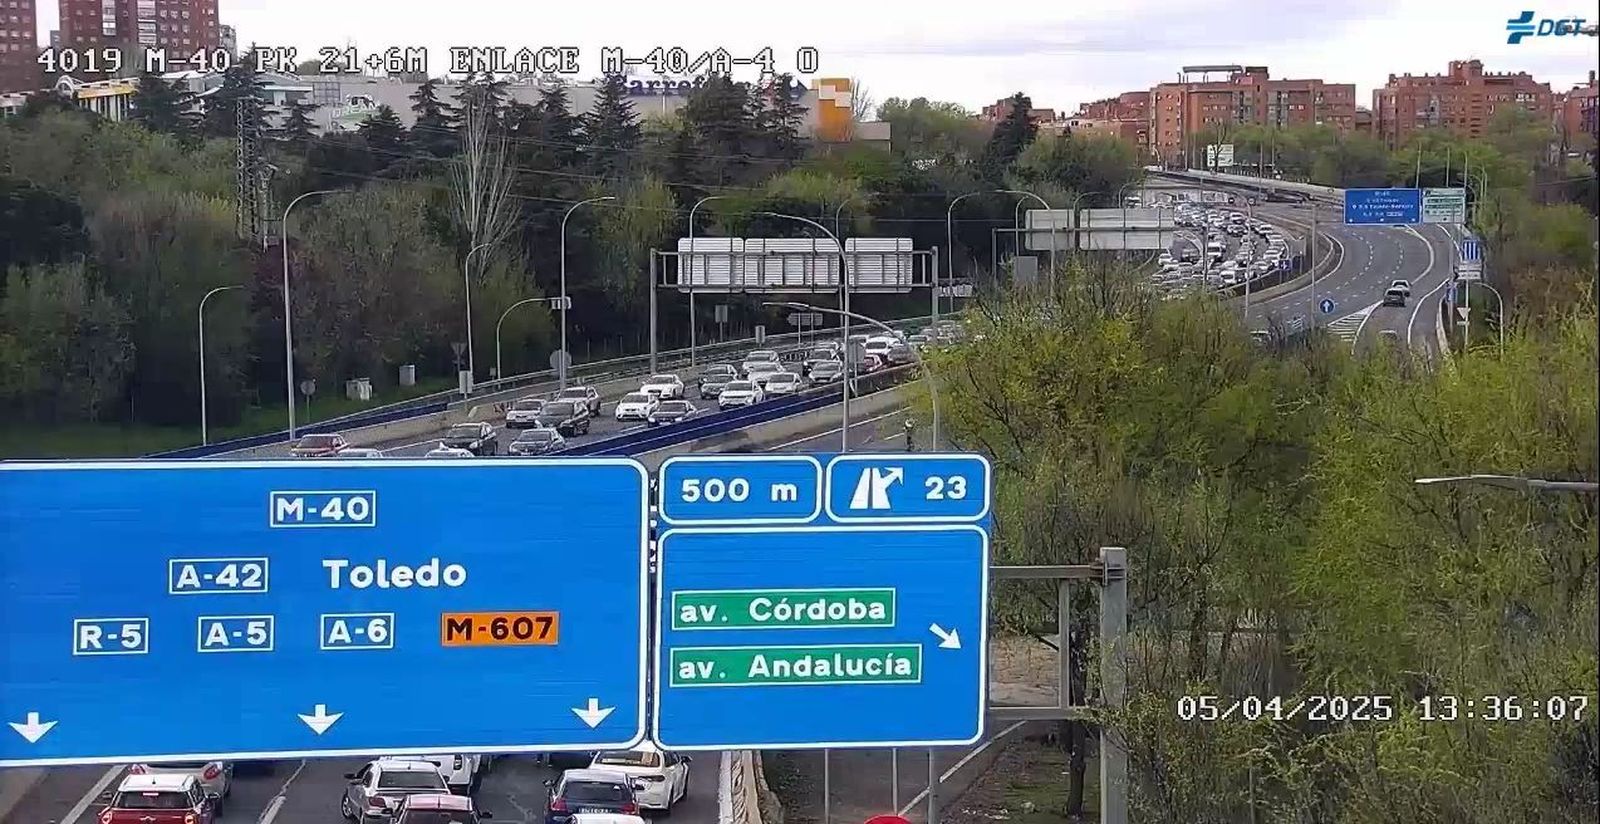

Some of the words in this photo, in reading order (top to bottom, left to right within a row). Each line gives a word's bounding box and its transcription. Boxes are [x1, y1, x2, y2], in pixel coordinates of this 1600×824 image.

[682, 478, 750, 502] 500
[771, 483, 797, 501] m
[925, 475, 967, 500] 23
[276, 496, 369, 521] M-40
[176, 563, 262, 589] A-42
[322, 558, 467, 589] Toledo
[680, 605, 728, 623] av.
[749, 597, 886, 621] Córdoba
[80, 623, 142, 648] R-5
[204, 621, 267, 646] A-5
[328, 618, 388, 644] A-6
[446, 616, 554, 642] M-607
[679, 661, 726, 679] av.
[748, 653, 912, 678] Andalucía
